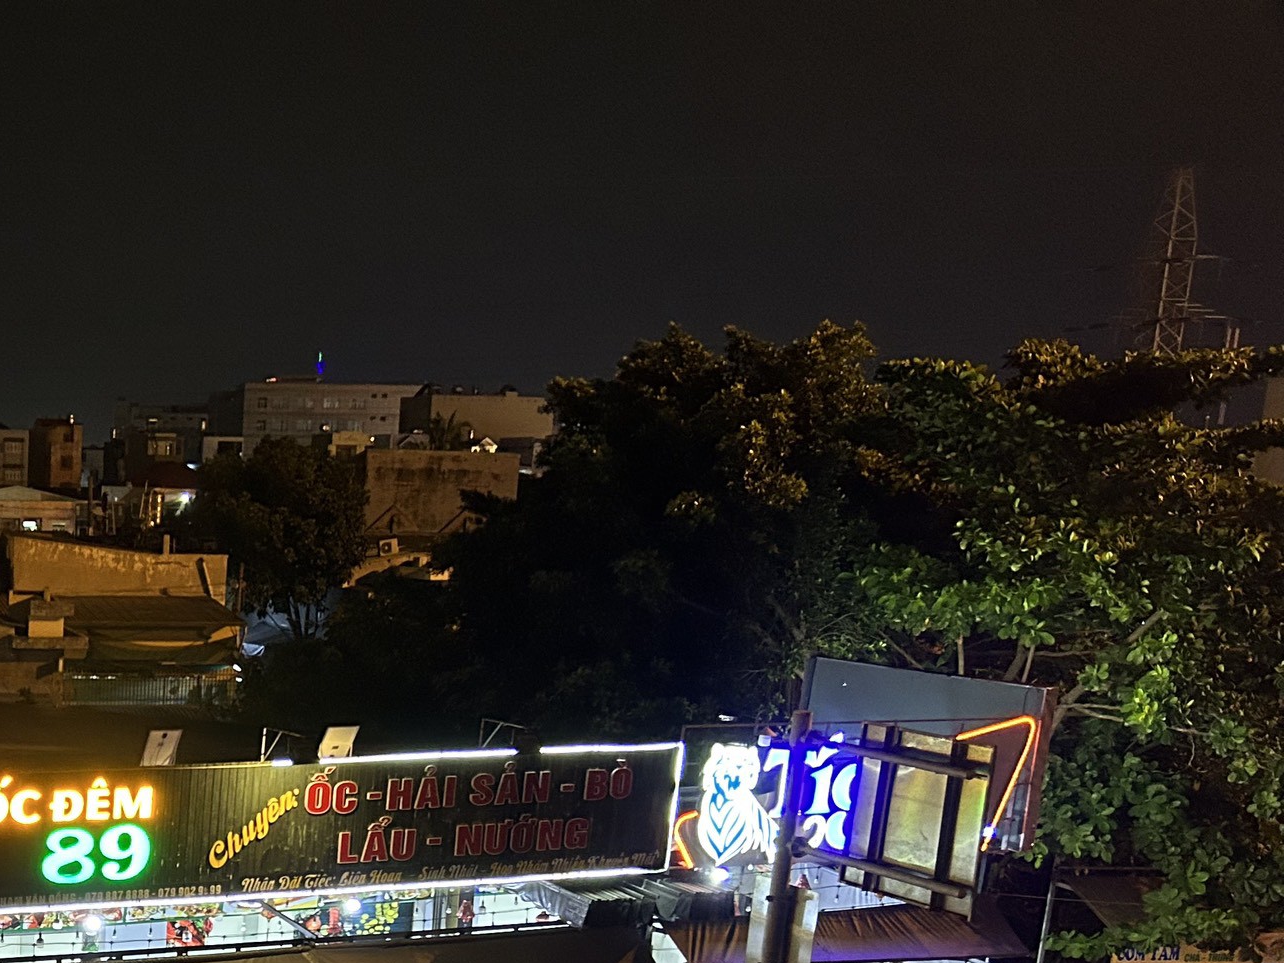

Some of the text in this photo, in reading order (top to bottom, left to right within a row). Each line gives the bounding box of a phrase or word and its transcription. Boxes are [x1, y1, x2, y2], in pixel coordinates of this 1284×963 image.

[48, 776, 154, 823] ĐÊM
[303, 766, 358, 815] ỐC
[386, 765, 455, 810] HẢI
[469, 761, 551, 806] SẢN
[41, 822, 152, 885] 89
[336, 816, 417, 865] LẨU
[454, 813, 589, 857] NƯỚNG
